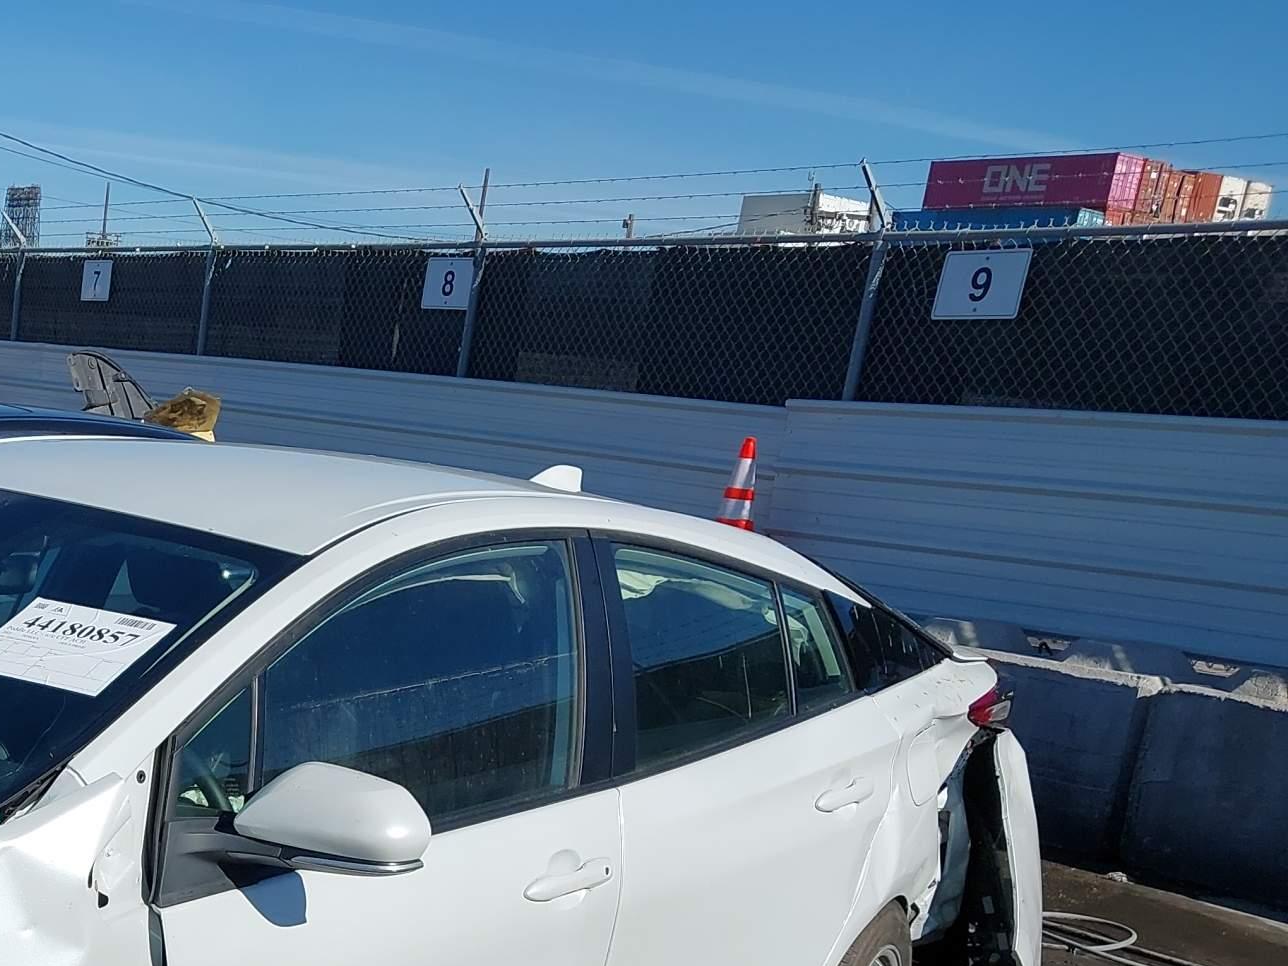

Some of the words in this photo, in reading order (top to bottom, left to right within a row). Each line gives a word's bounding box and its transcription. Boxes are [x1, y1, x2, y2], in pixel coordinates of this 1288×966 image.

[982, 163, 1052, 193] ONE
[94, 271, 101, 290] 7
[442, 270, 455, 297] 8
[968, 267, 992, 302] 9
[23, 615, 141, 647] 44180857
